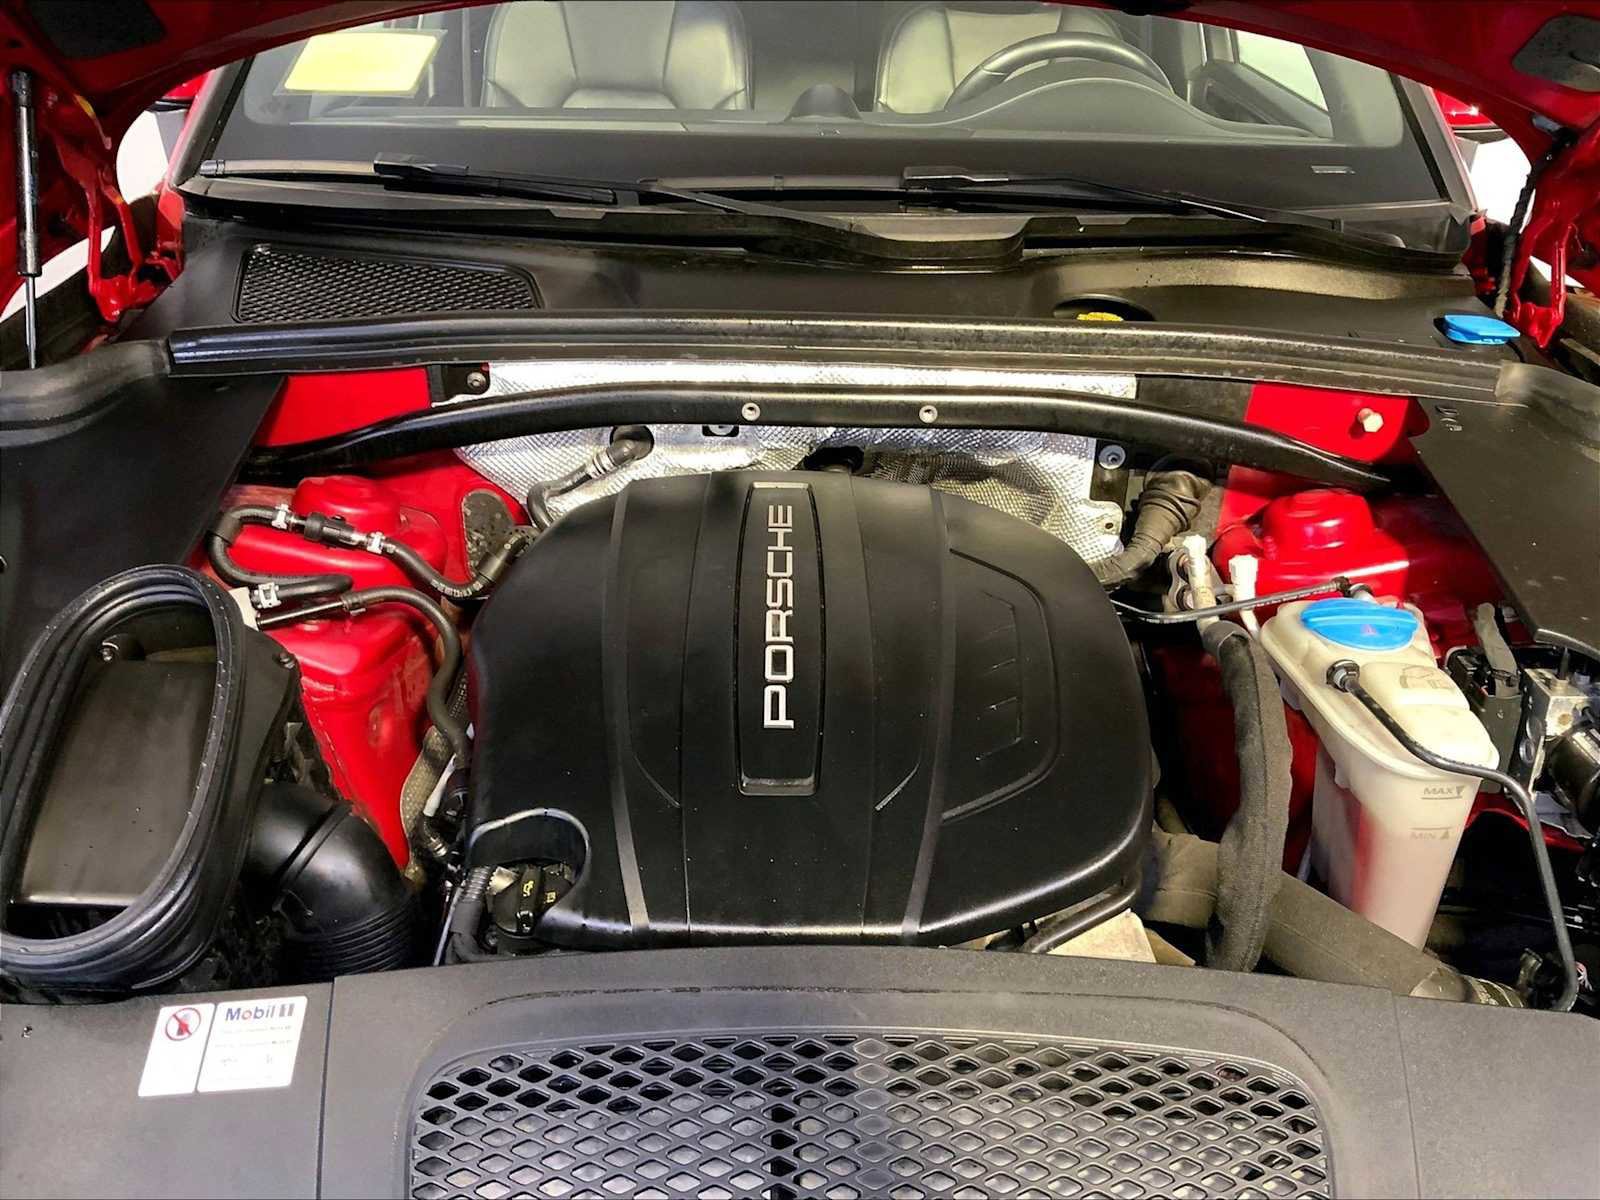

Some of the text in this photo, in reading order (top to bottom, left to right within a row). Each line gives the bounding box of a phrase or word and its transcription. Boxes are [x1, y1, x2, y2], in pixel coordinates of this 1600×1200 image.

[763, 505, 794, 730] PORSCHE
[1423, 787, 1453, 795] MAX
[225, 1005, 276, 1021] Mobil
